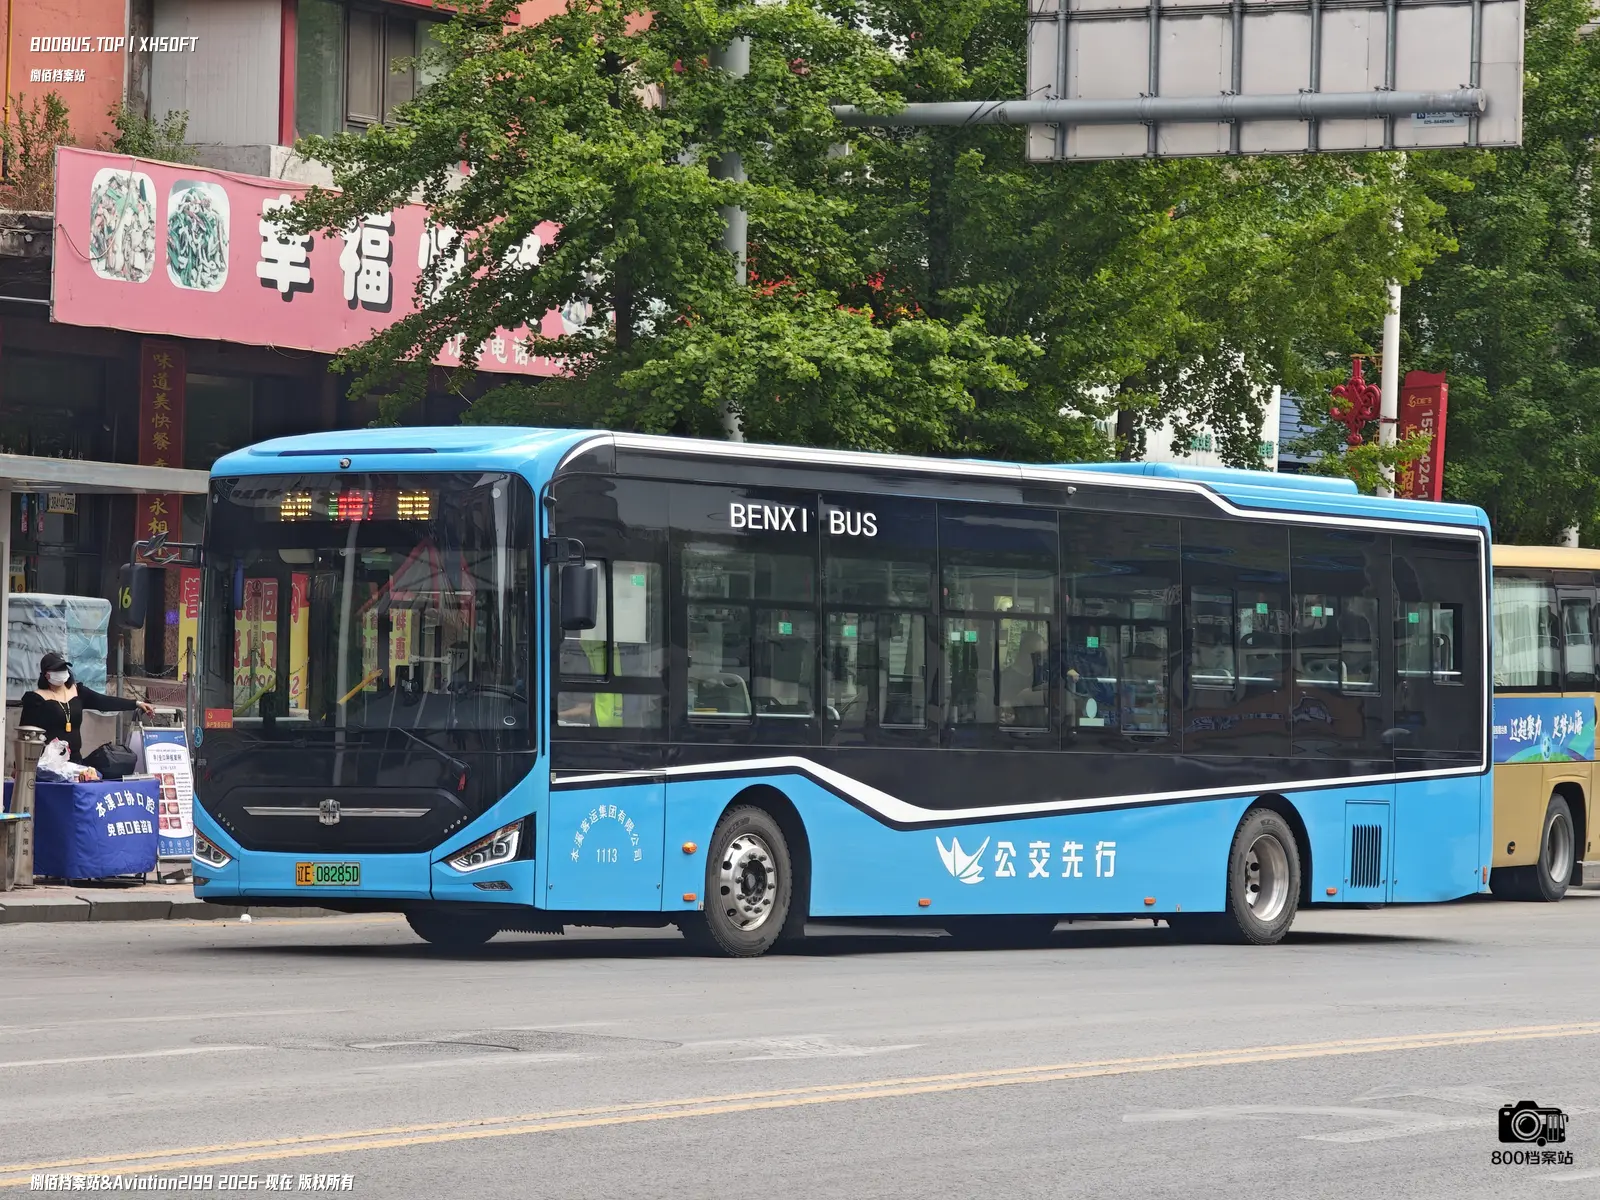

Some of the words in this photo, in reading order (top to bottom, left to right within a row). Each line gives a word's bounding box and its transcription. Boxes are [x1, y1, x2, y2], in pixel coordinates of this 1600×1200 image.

[729, 502, 808, 533] BENXI
[829, 510, 878, 537] BUS
[571, 804, 643, 863] 本溪客运集团有限公司
[596, 848, 618, 863] 1113
[994, 840, 1117, 878] 公交先行
